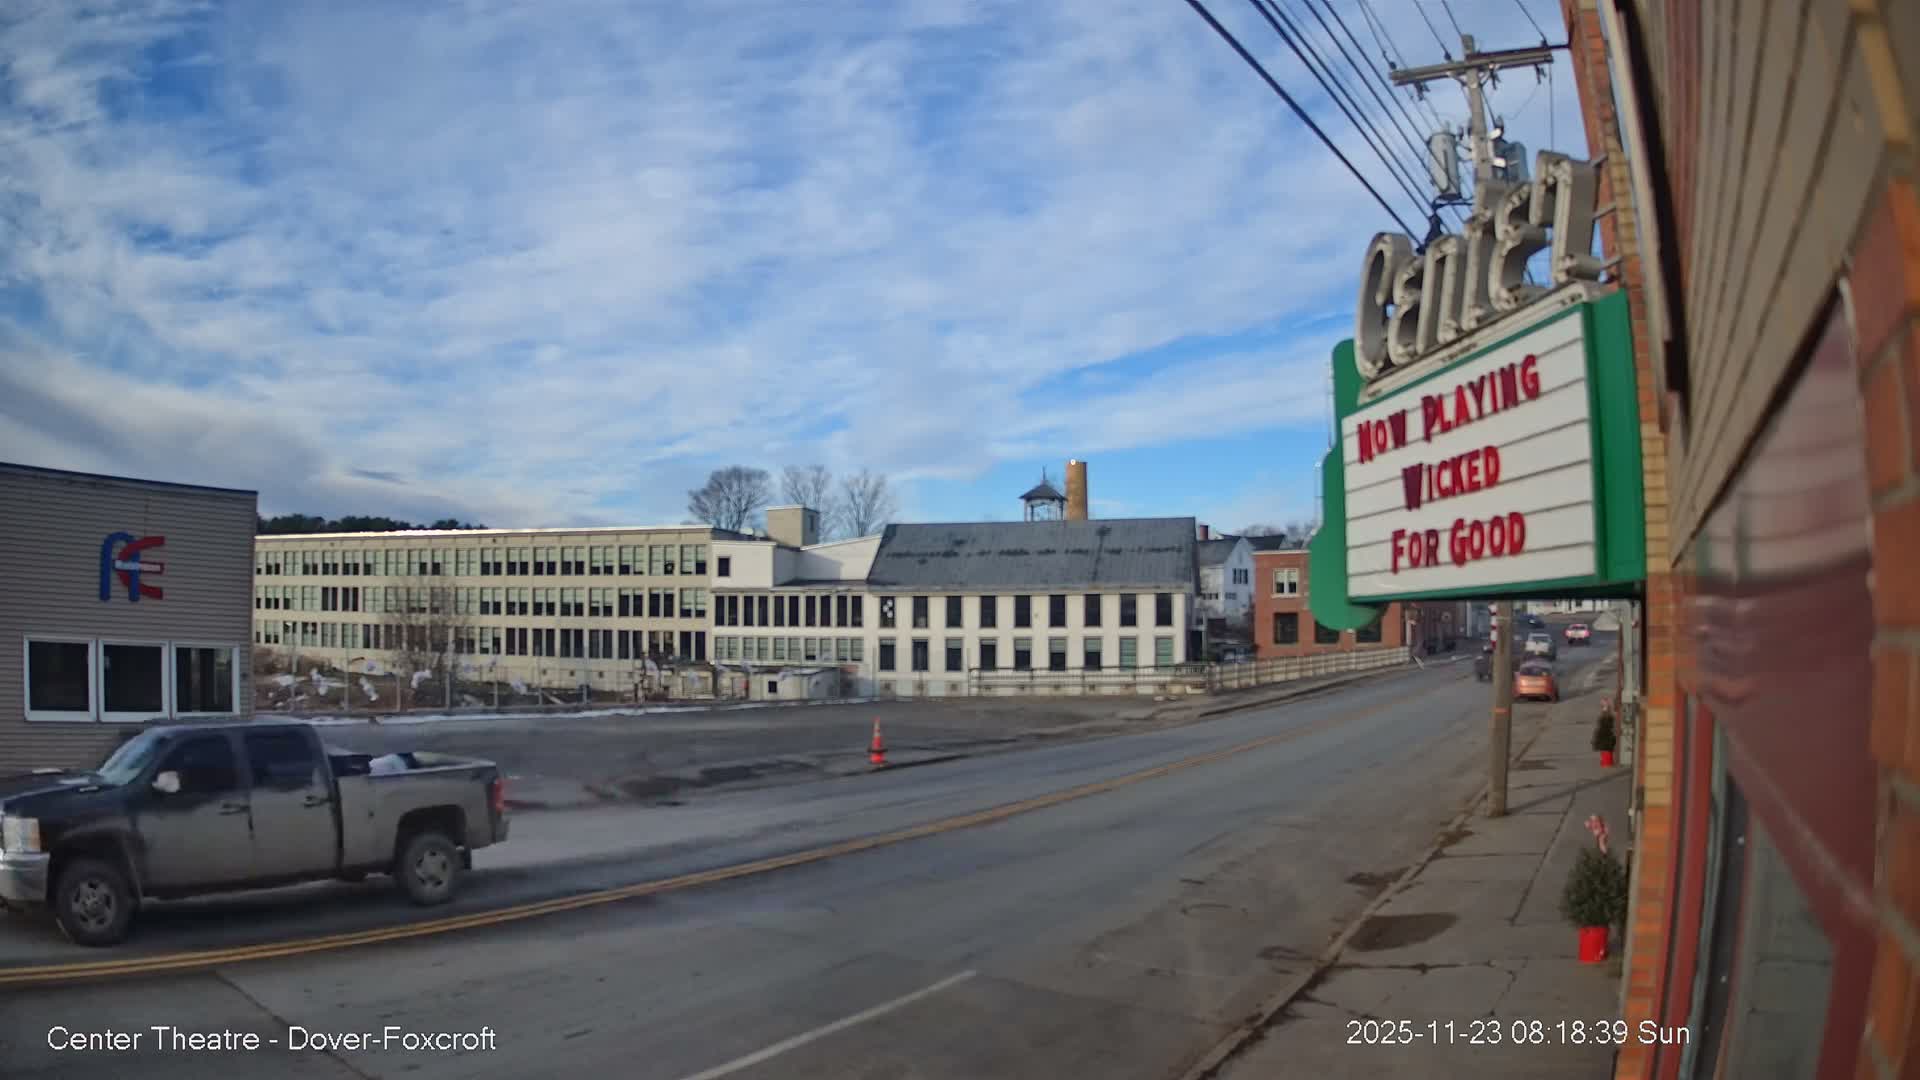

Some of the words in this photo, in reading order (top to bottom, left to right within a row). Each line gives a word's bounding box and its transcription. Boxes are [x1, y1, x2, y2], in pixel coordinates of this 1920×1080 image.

[1421, 354, 1541, 442] PLAYING
[1402, 445, 1501, 511] WICKED
[1391, 528, 1440, 575] FOR
[1450, 511, 1527, 566] GOOD
